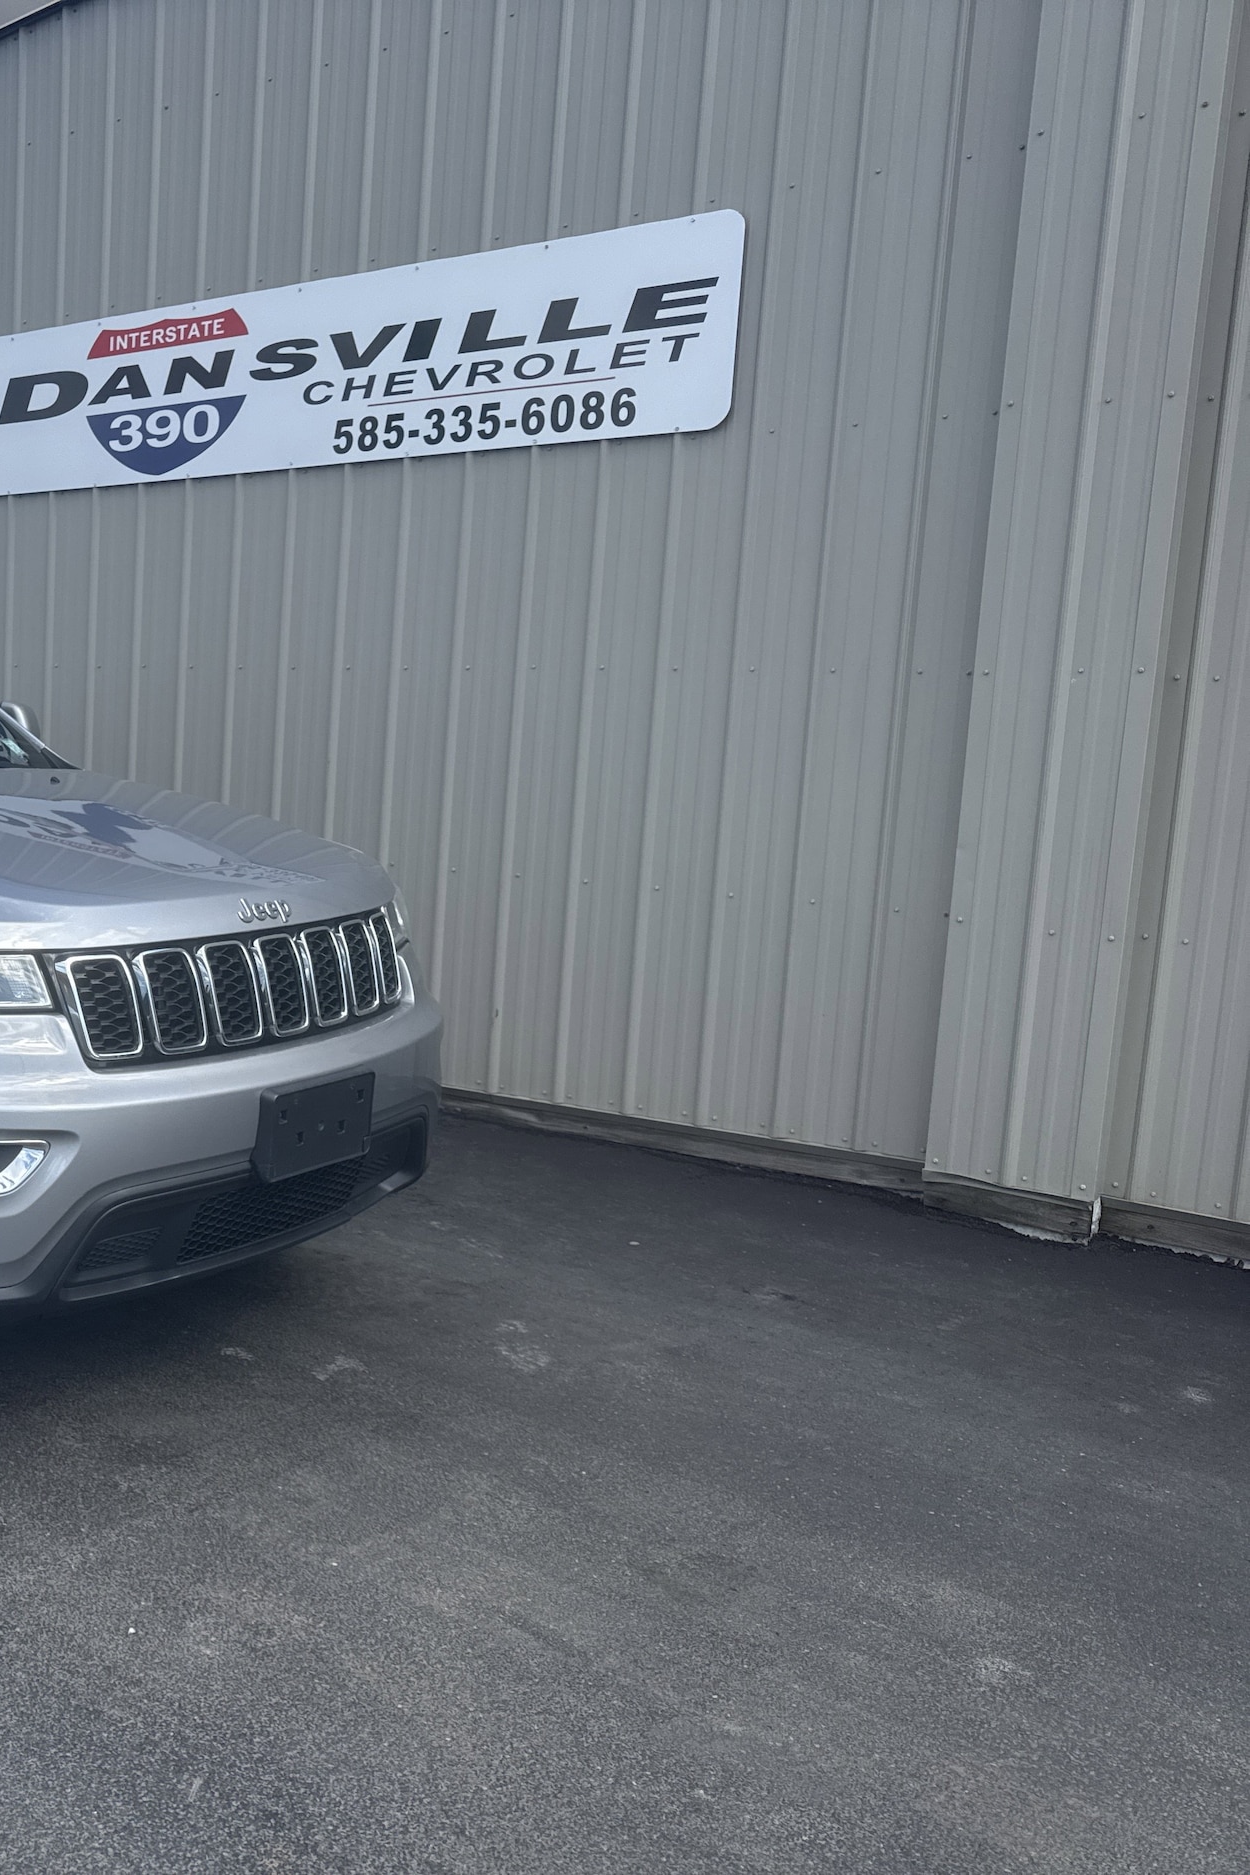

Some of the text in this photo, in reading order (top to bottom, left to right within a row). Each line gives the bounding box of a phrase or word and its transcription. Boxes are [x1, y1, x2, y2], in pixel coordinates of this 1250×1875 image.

[108, 318, 225, 352] INTERSTATE
[303, 332, 700, 406] CHEVROLET
[107, 402, 221, 453] 390
[332, 386, 637, 455] 585-335-6086
[237, 898, 291, 923] Jeep
